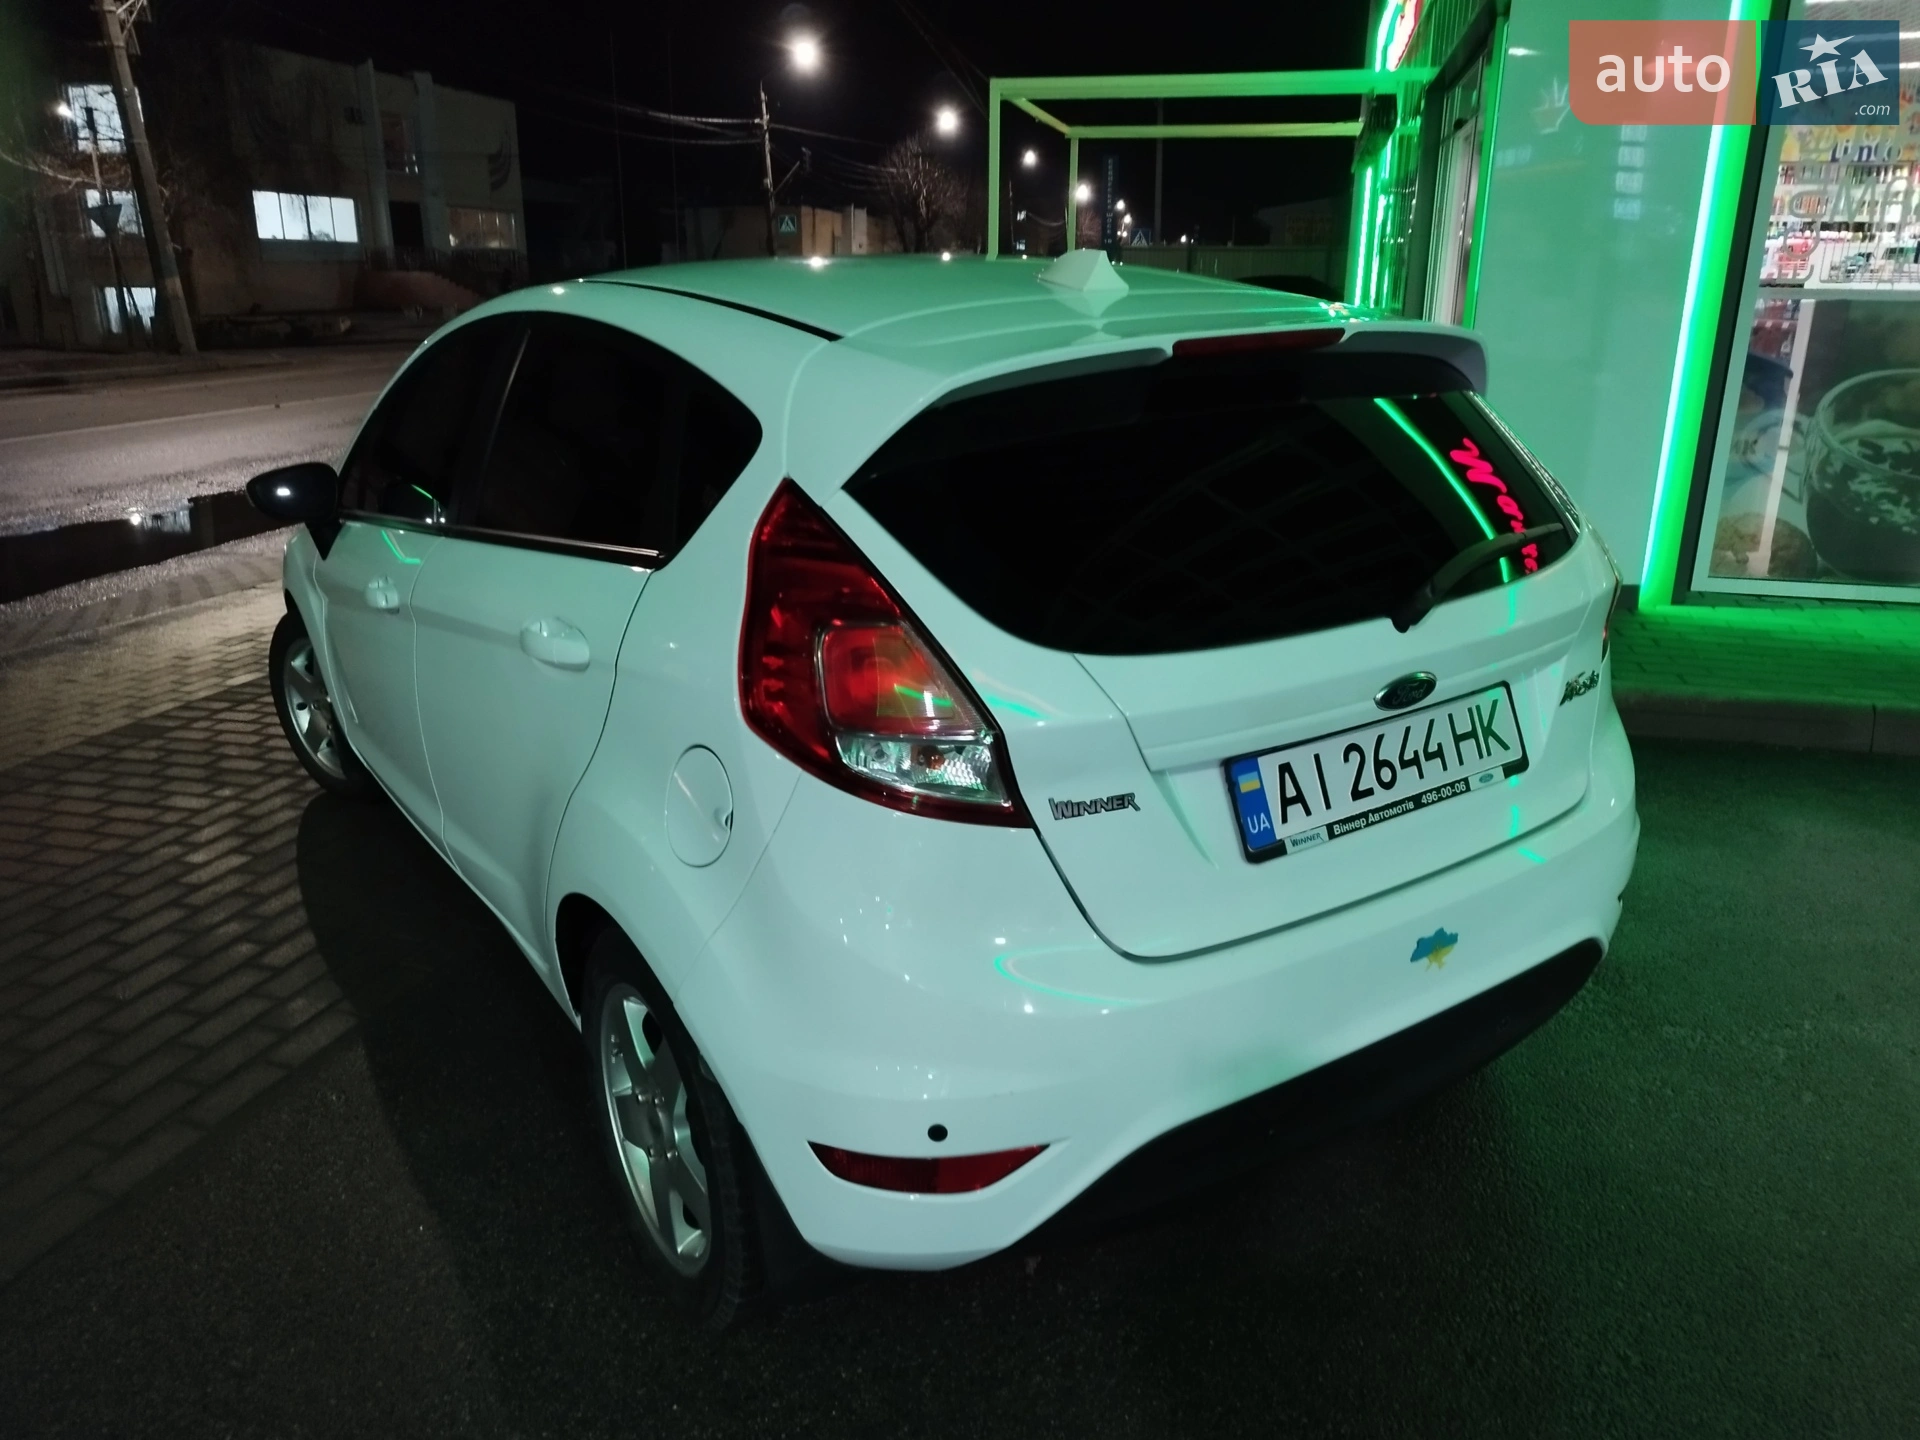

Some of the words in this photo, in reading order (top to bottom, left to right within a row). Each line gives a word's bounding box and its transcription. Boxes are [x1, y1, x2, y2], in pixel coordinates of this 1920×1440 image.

[1342, 717, 1448, 802] 2644
[1448, 698, 1511, 766] HK
[1048, 792, 1141, 820] WINNER
[1333, 817, 1367, 836] Віннер
[1368, 799, 1414, 824] Автомотів
[1421, 781, 1467, 805] 496-00-06
[1248, 812, 1271, 834] UA
[1290, 832, 1324, 848] WINNER
